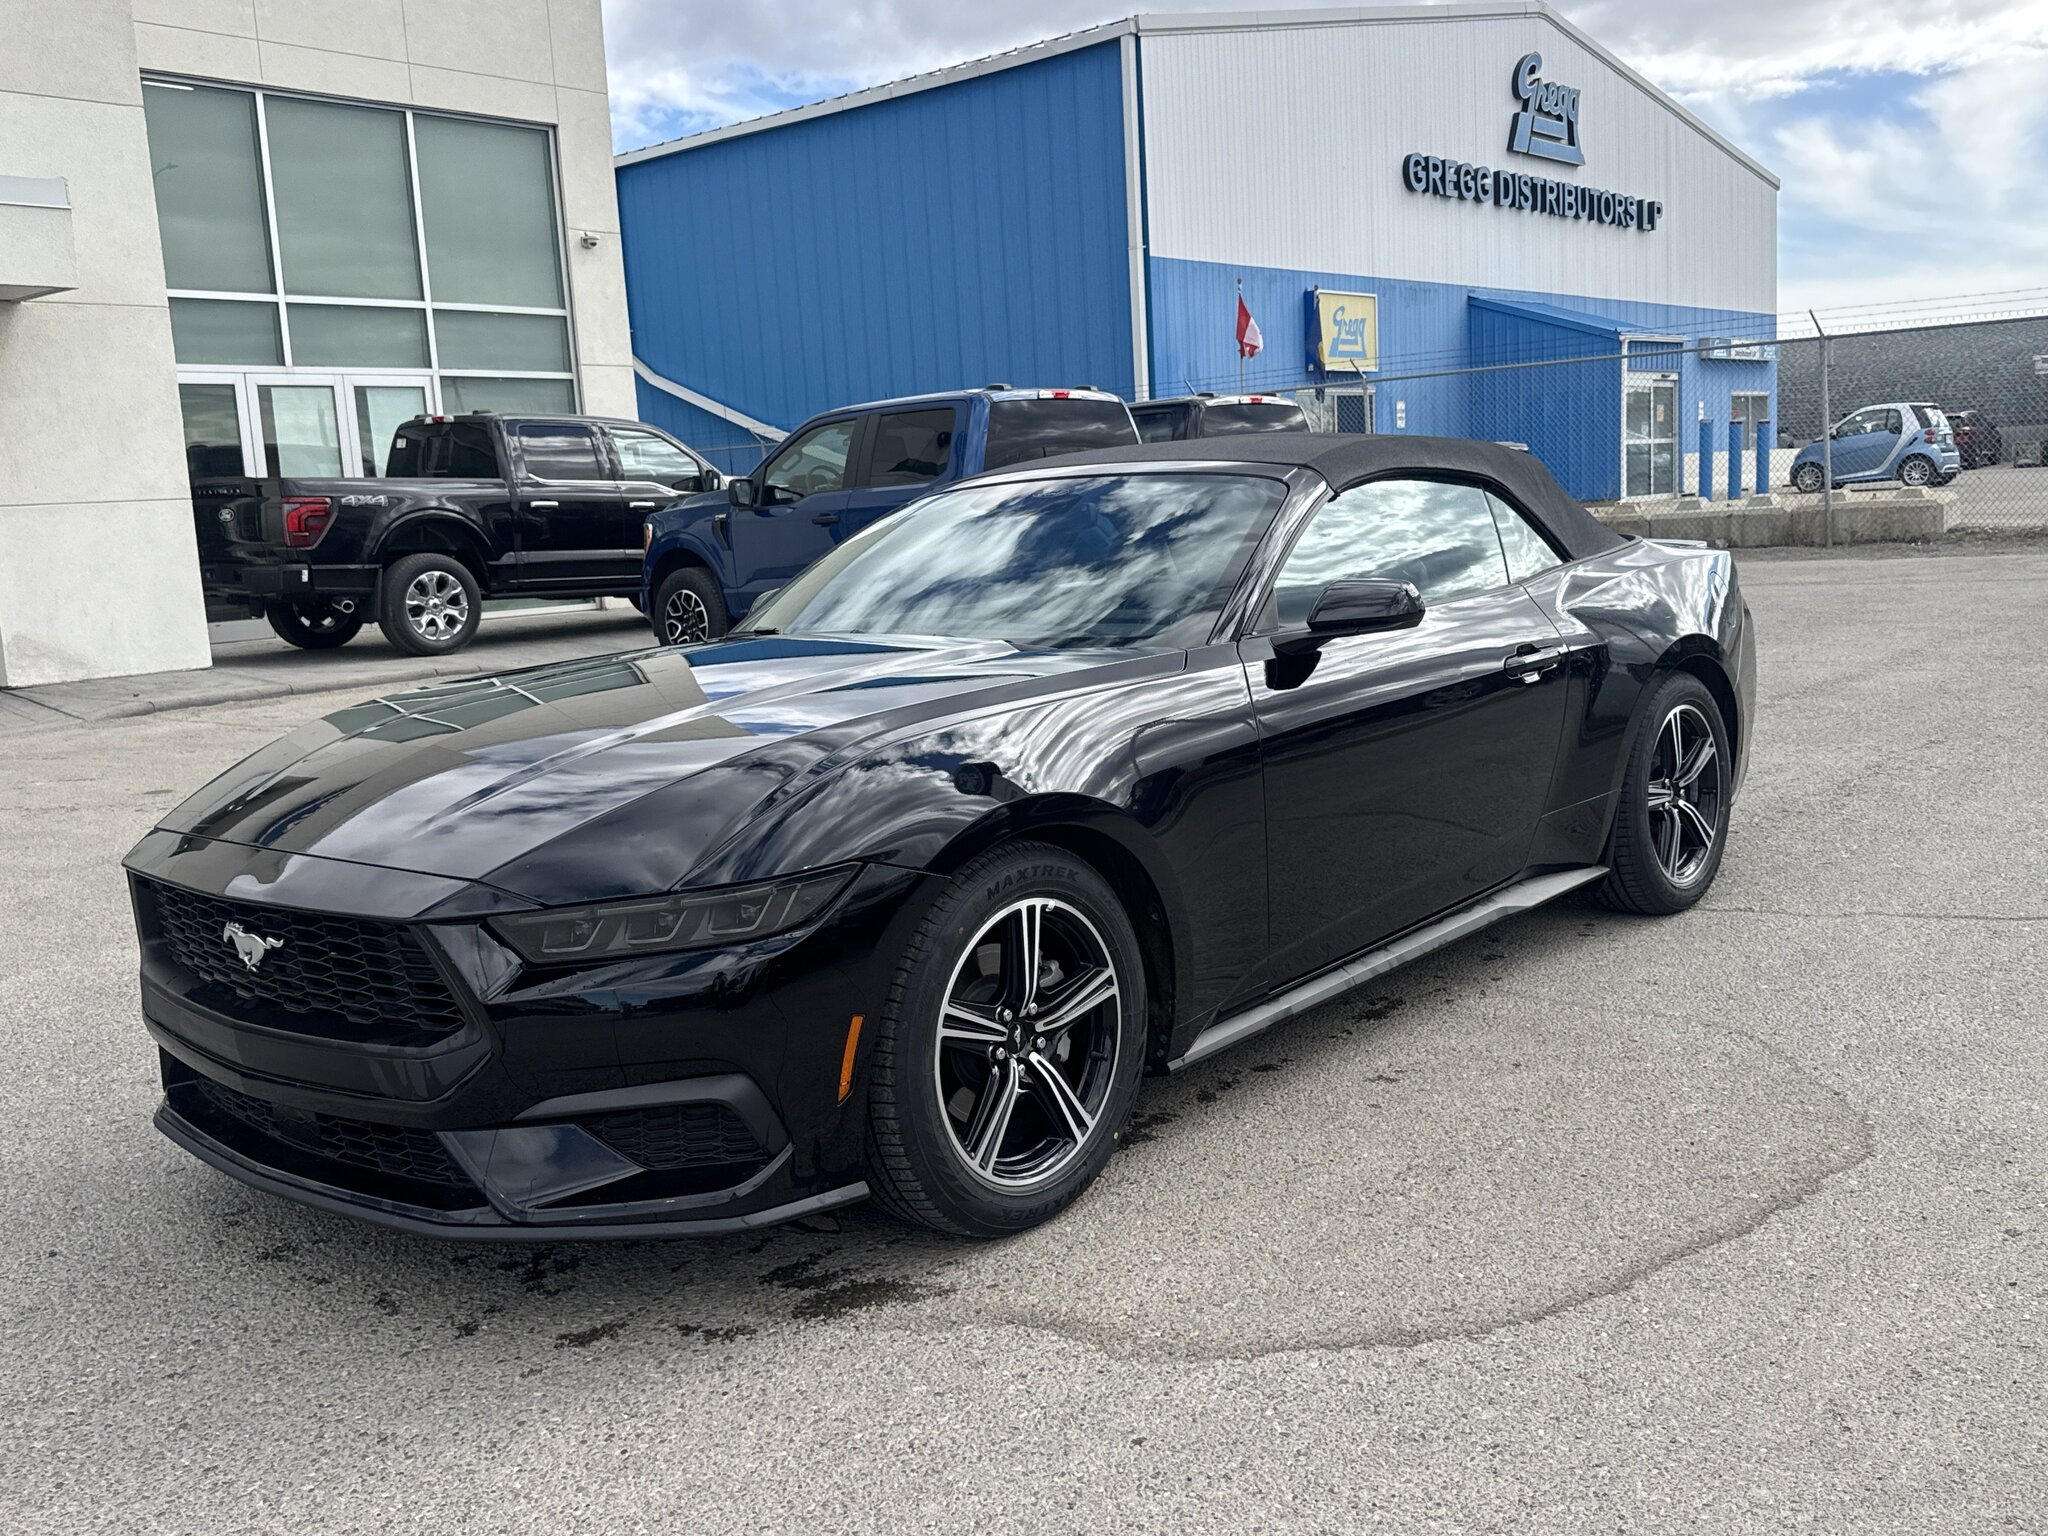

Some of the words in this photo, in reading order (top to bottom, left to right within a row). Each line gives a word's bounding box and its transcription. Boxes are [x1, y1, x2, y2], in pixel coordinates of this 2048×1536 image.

[1508, 51, 1584, 160] Gregg
[1404, 153, 1492, 202] GREGG
[1494, 170, 1637, 228] DISTRIBUTORS
[1638, 199, 1663, 231] LP
[986, 865, 1079, 900] MAXTREK
